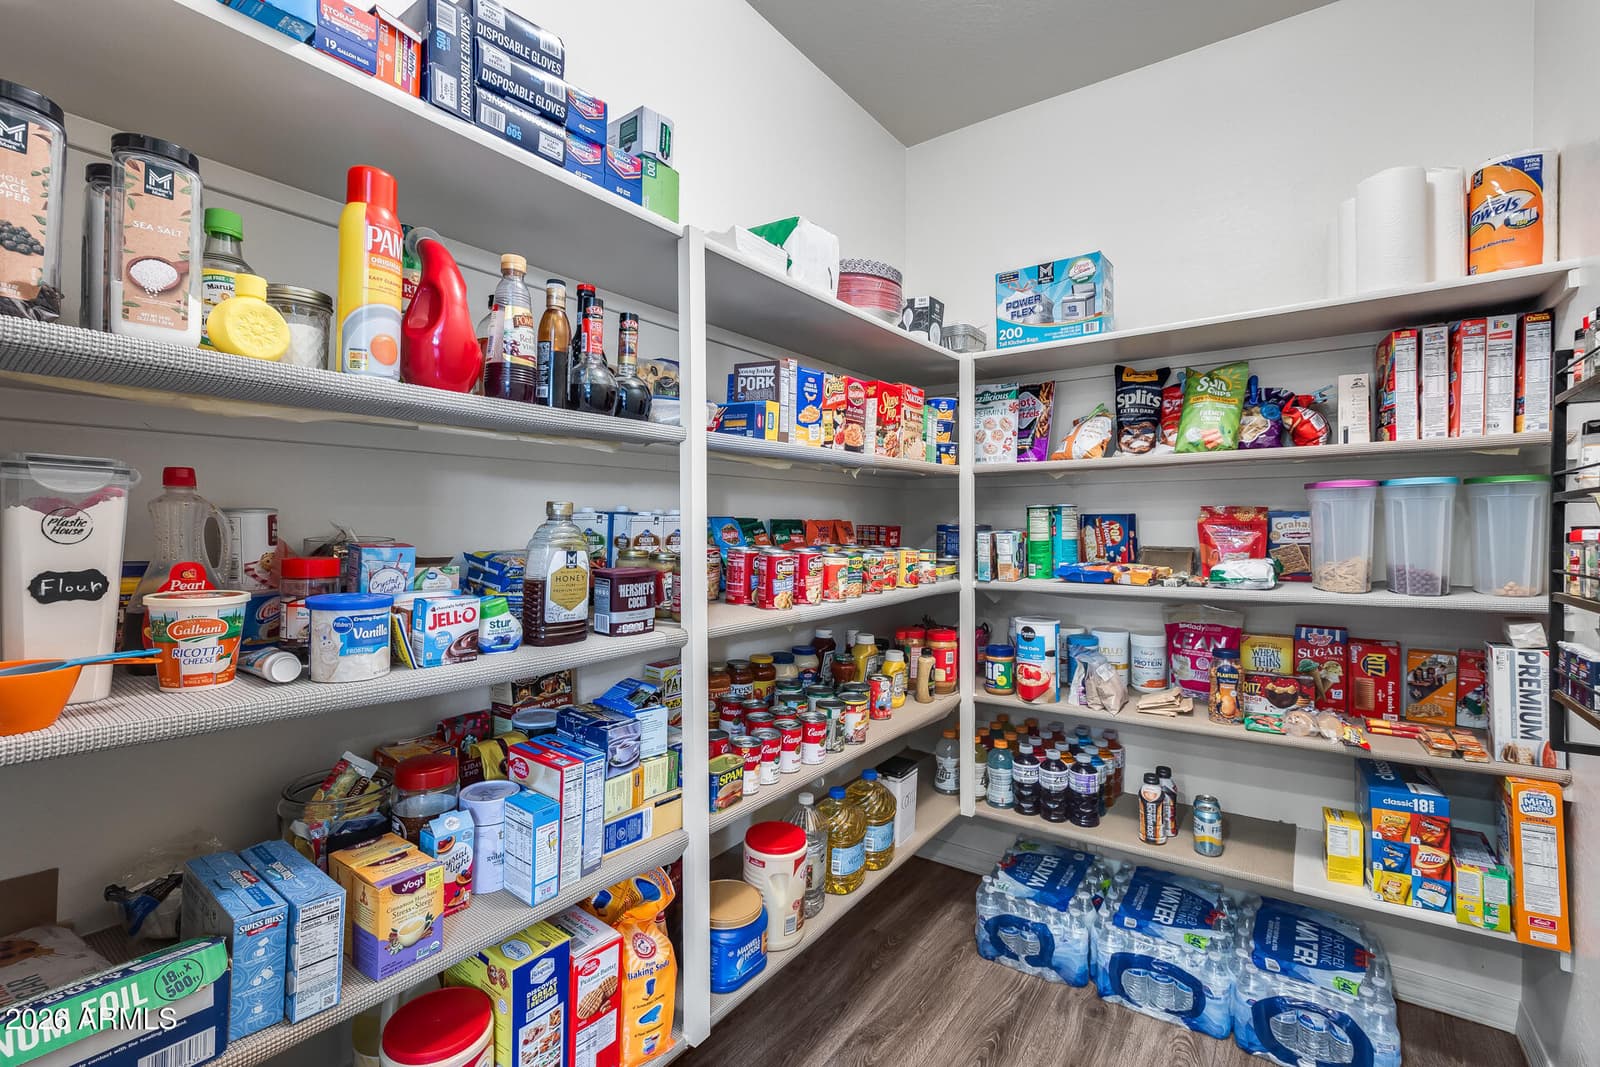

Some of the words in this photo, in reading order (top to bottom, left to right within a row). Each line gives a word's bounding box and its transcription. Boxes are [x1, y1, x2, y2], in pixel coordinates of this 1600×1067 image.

[437, 31, 447, 51] 500
[460, 13, 471, 54] GLOVES
[324, 36, 337, 50] 19
[477, 22, 530, 59] DISPOSABLE
[531, 46, 562, 75] GLOVES
[460, 53, 471, 117] DISPOSABLE
[481, 67, 535, 105] DISPOSABLE
[535, 90, 566, 119] GLOVES
[506, 126, 522, 141] 500
[132, 220, 154, 231] SEA
[157, 225, 184, 237] SALT
[366, 225, 403, 263] PAM
[1005, 294, 1042, 312] POWER
[1010, 305, 1037, 320] FLEX
[999, 326, 1023, 340] 200
[737, 376, 776, 393] PORK
[1020, 398, 1037, 408] ot's
[1019, 410, 1041, 419] tzels
[47, 516, 88, 529] Plastic
[51, 524, 85, 537] House
[170, 579, 206, 591] Pearl
[371, 576, 398, 591] Crystal
[555, 573, 586, 583] HONEY
[39, 578, 103, 596] Flour
[617, 581, 655, 598] HERSHEY'S
[628, 597, 647, 609] COCOA
[172, 623, 223, 636] Galbani
[352, 624, 388, 640] Vanilla
[489, 619, 512, 630] stur
[1173, 632, 1229, 652] LEAN
[172, 646, 224, 658] RICOTTA
[345, 646, 375, 655] FROSTING
[1252, 647, 1281, 659] WHEAT
[1297, 647, 1344, 659] SUGAR
[182, 656, 215, 666] CHEESE
[1133, 659, 1163, 667] PROTEIN
[1252, 656, 1281, 669] THINS
[1367, 653, 1387, 678] RITZ
[1243, 681, 1262, 695] RITZ
[1517, 650, 1543, 742] PREMIUM
[541, 696, 557, 707] Apple
[557, 696, 569, 705] Spice
[719, 767, 744, 787] SPAM
[1383, 797, 1414, 809] classic
[1412, 798, 1429, 813] 18
[1521, 805, 1553, 816] Wheats
[1524, 798, 1551, 809] Mini
[1420, 852, 1445, 864] Fritos
[1026, 855, 1060, 888] WATER
[401, 876, 425, 893] yogi
[1151, 885, 1183, 926] WATER
[736, 935, 762, 958] MAXWELL
[1292, 919, 1320, 967] WATER
[742, 945, 762, 961] HOUSE
[627, 966, 655, 981] Baking
[655, 960, 671, 972] Soda
[526, 976, 558, 999] DISCOVER
[81, 982, 149, 1027] FOIL
[87, 1051, 113, 1066] contact
[113, 1044, 128, 1055] with
[128, 1039, 140, 1048] the
